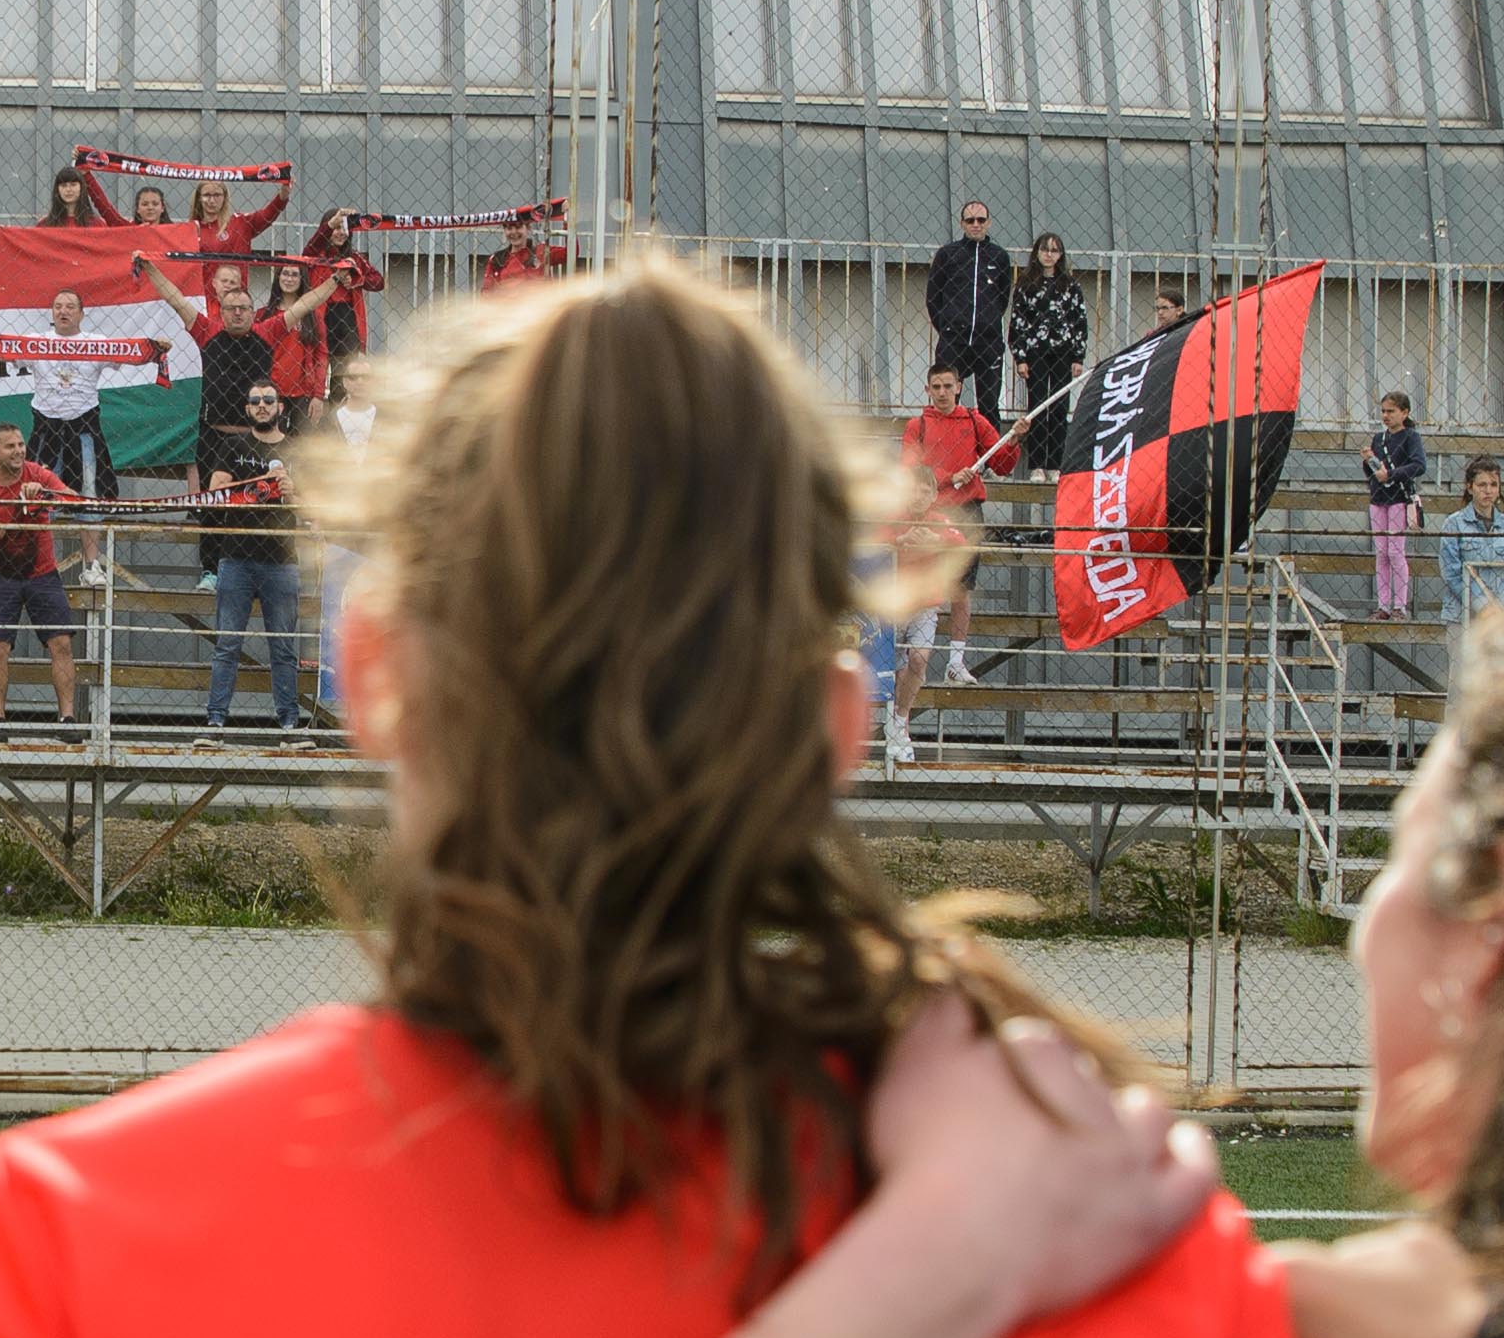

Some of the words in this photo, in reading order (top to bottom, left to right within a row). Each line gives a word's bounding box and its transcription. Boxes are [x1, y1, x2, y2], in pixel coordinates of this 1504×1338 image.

[121, 160, 141, 172] FK
[395, 215, 414, 227] FK
[1, 340, 22, 353] FK
